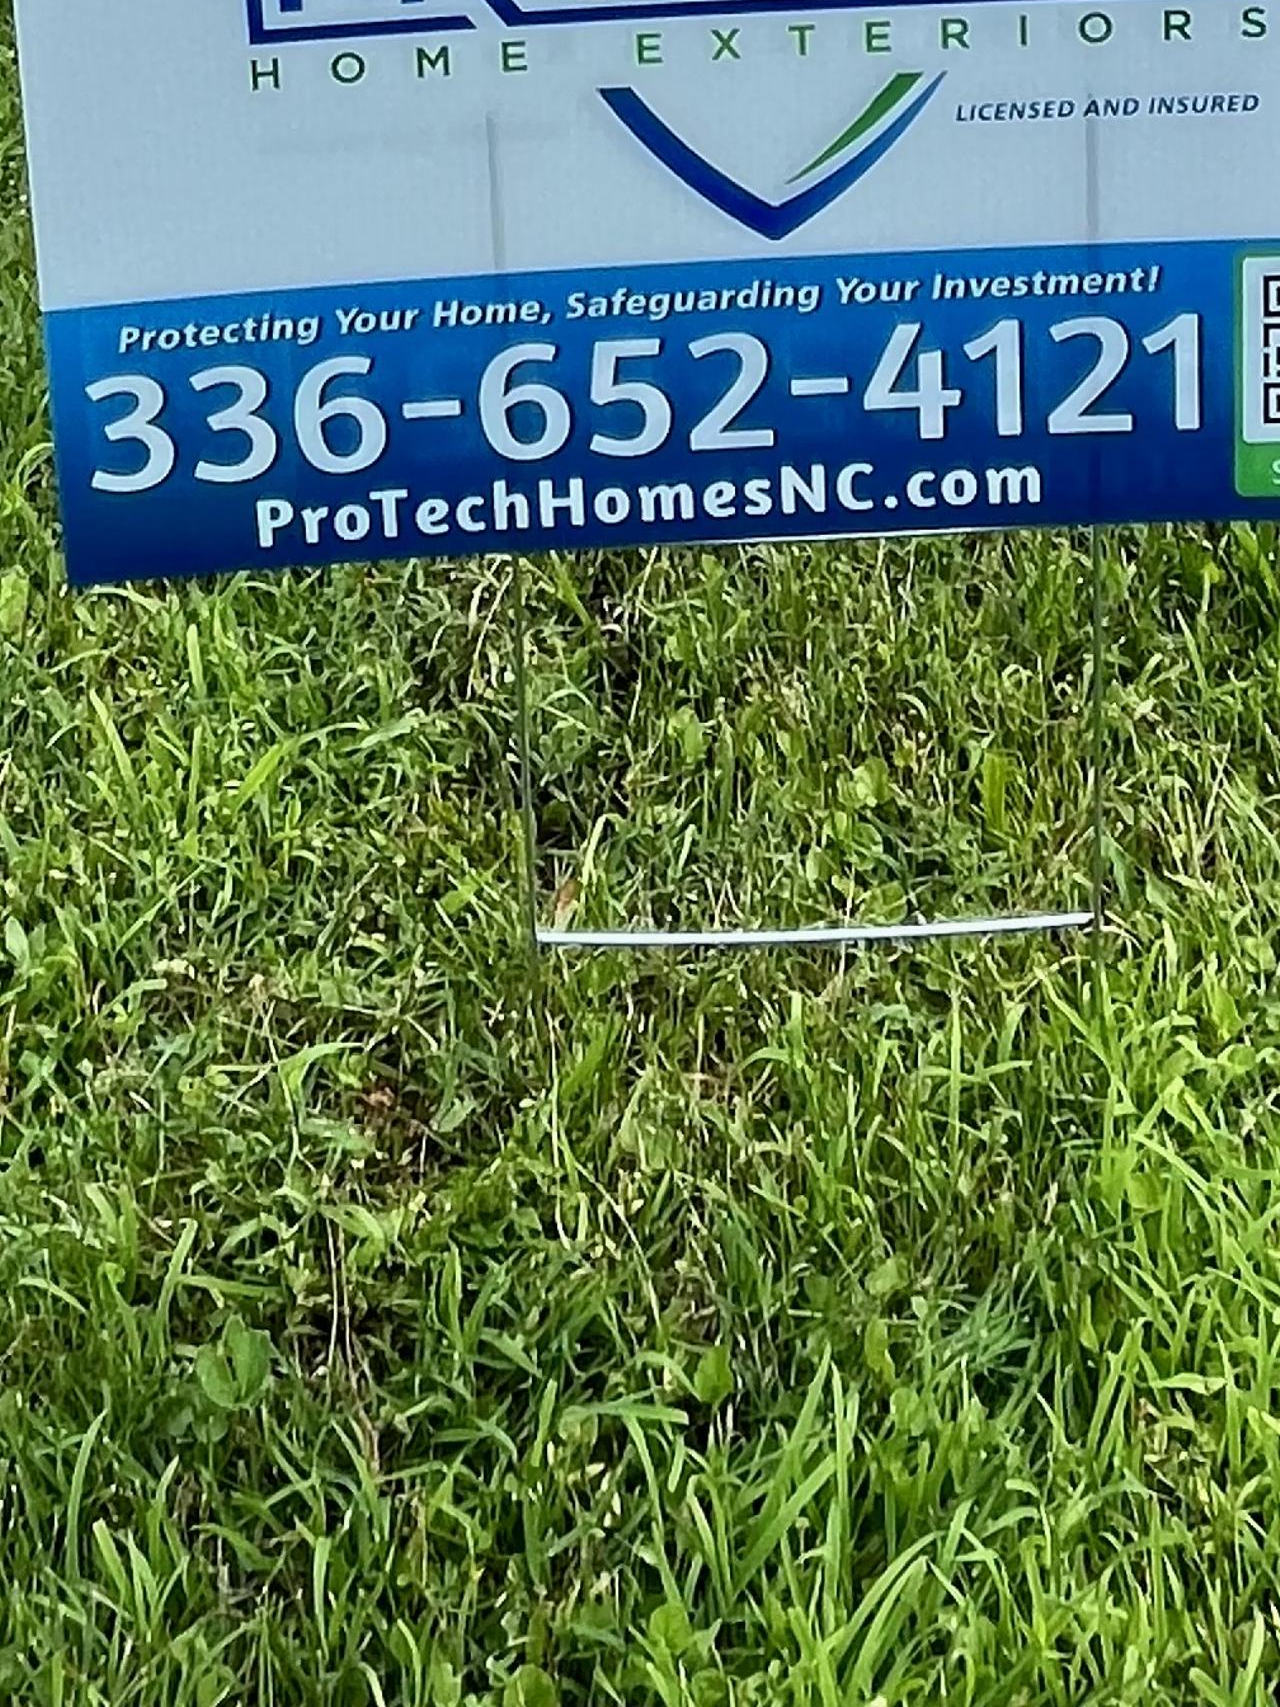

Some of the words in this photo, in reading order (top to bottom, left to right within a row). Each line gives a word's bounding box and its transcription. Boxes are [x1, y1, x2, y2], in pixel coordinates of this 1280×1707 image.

[250, 40, 528, 91] HOME
[635, 6, 1267, 67] EXTERIORS
[955, 99, 1075, 122] LICENSED
[1082, 97, 1140, 118] AND
[1148, 94, 1260, 116] INSURED
[118, 312, 319, 354] Protecting
[334, 306, 419, 336] Your
[433, 296, 552, 328] Home,
[566, 278, 820, 321] Safeguarding
[836, 274, 920, 305] Your
[931, 265, 1161, 300] Investment!
[83, 312, 1201, 493] 336-652-4121
[256, 463, 1042, 548] ProTechHomesNC.com
